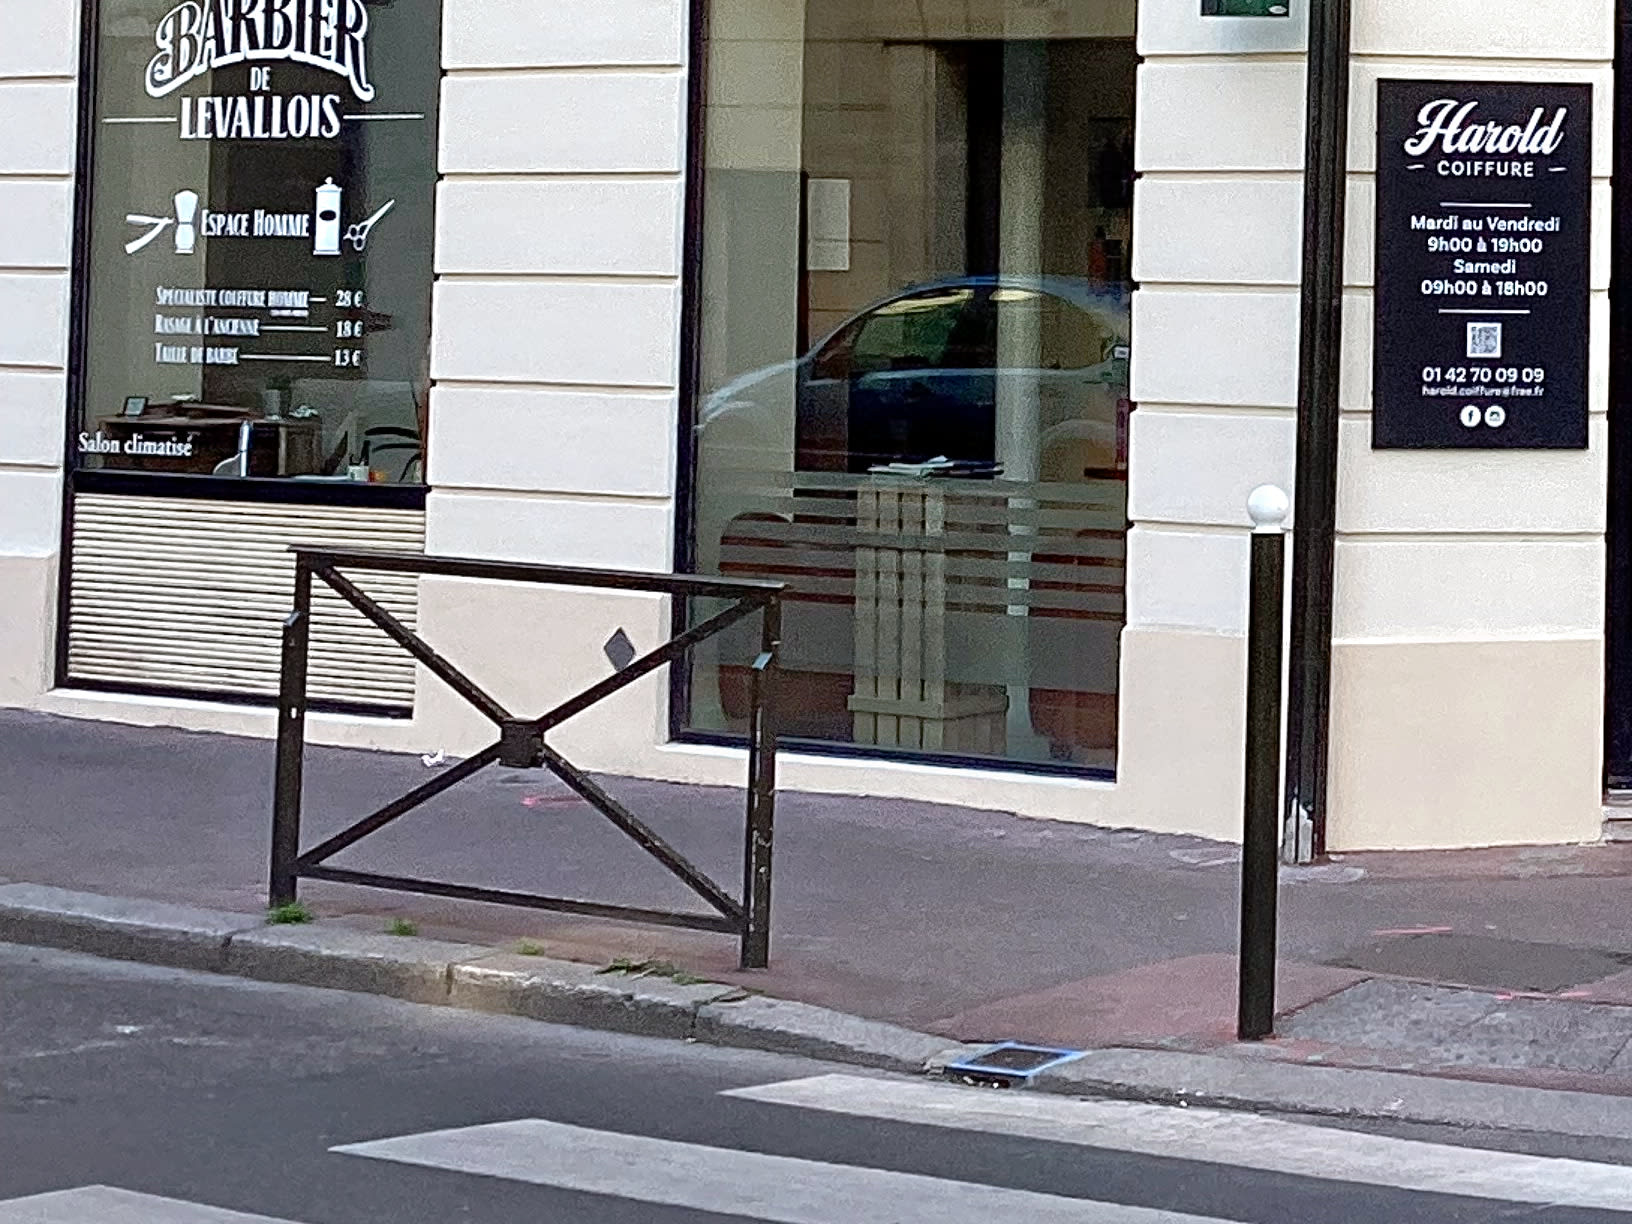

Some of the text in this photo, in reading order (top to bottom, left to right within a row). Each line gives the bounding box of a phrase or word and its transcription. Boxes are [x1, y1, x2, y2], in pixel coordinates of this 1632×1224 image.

[250, 67, 271, 91] DE
[180, 95, 341, 138] LEVALLOIS
[1404, 99, 1567, 156] Harold
[1437, 160, 1534, 177] COIFFURE
[1411, 215, 1560, 231] Mardi au Vendredi
[1427, 236, 1543, 253] 9h00 à 19h00
[1453, 259, 1516, 274] Samedi
[1421, 280, 1548, 296] 09h00 à 18h00
[336, 290, 352, 307] 28
[354, 290, 363, 307] €
[336, 320, 352, 338] 18
[354, 320, 363, 338] €
[335, 349, 350, 366] 13
[352, 349, 361, 366] €
[1422, 367, 1544, 383] 01 42 70 09 09
[78, 431, 192, 456] Salon climatisé
